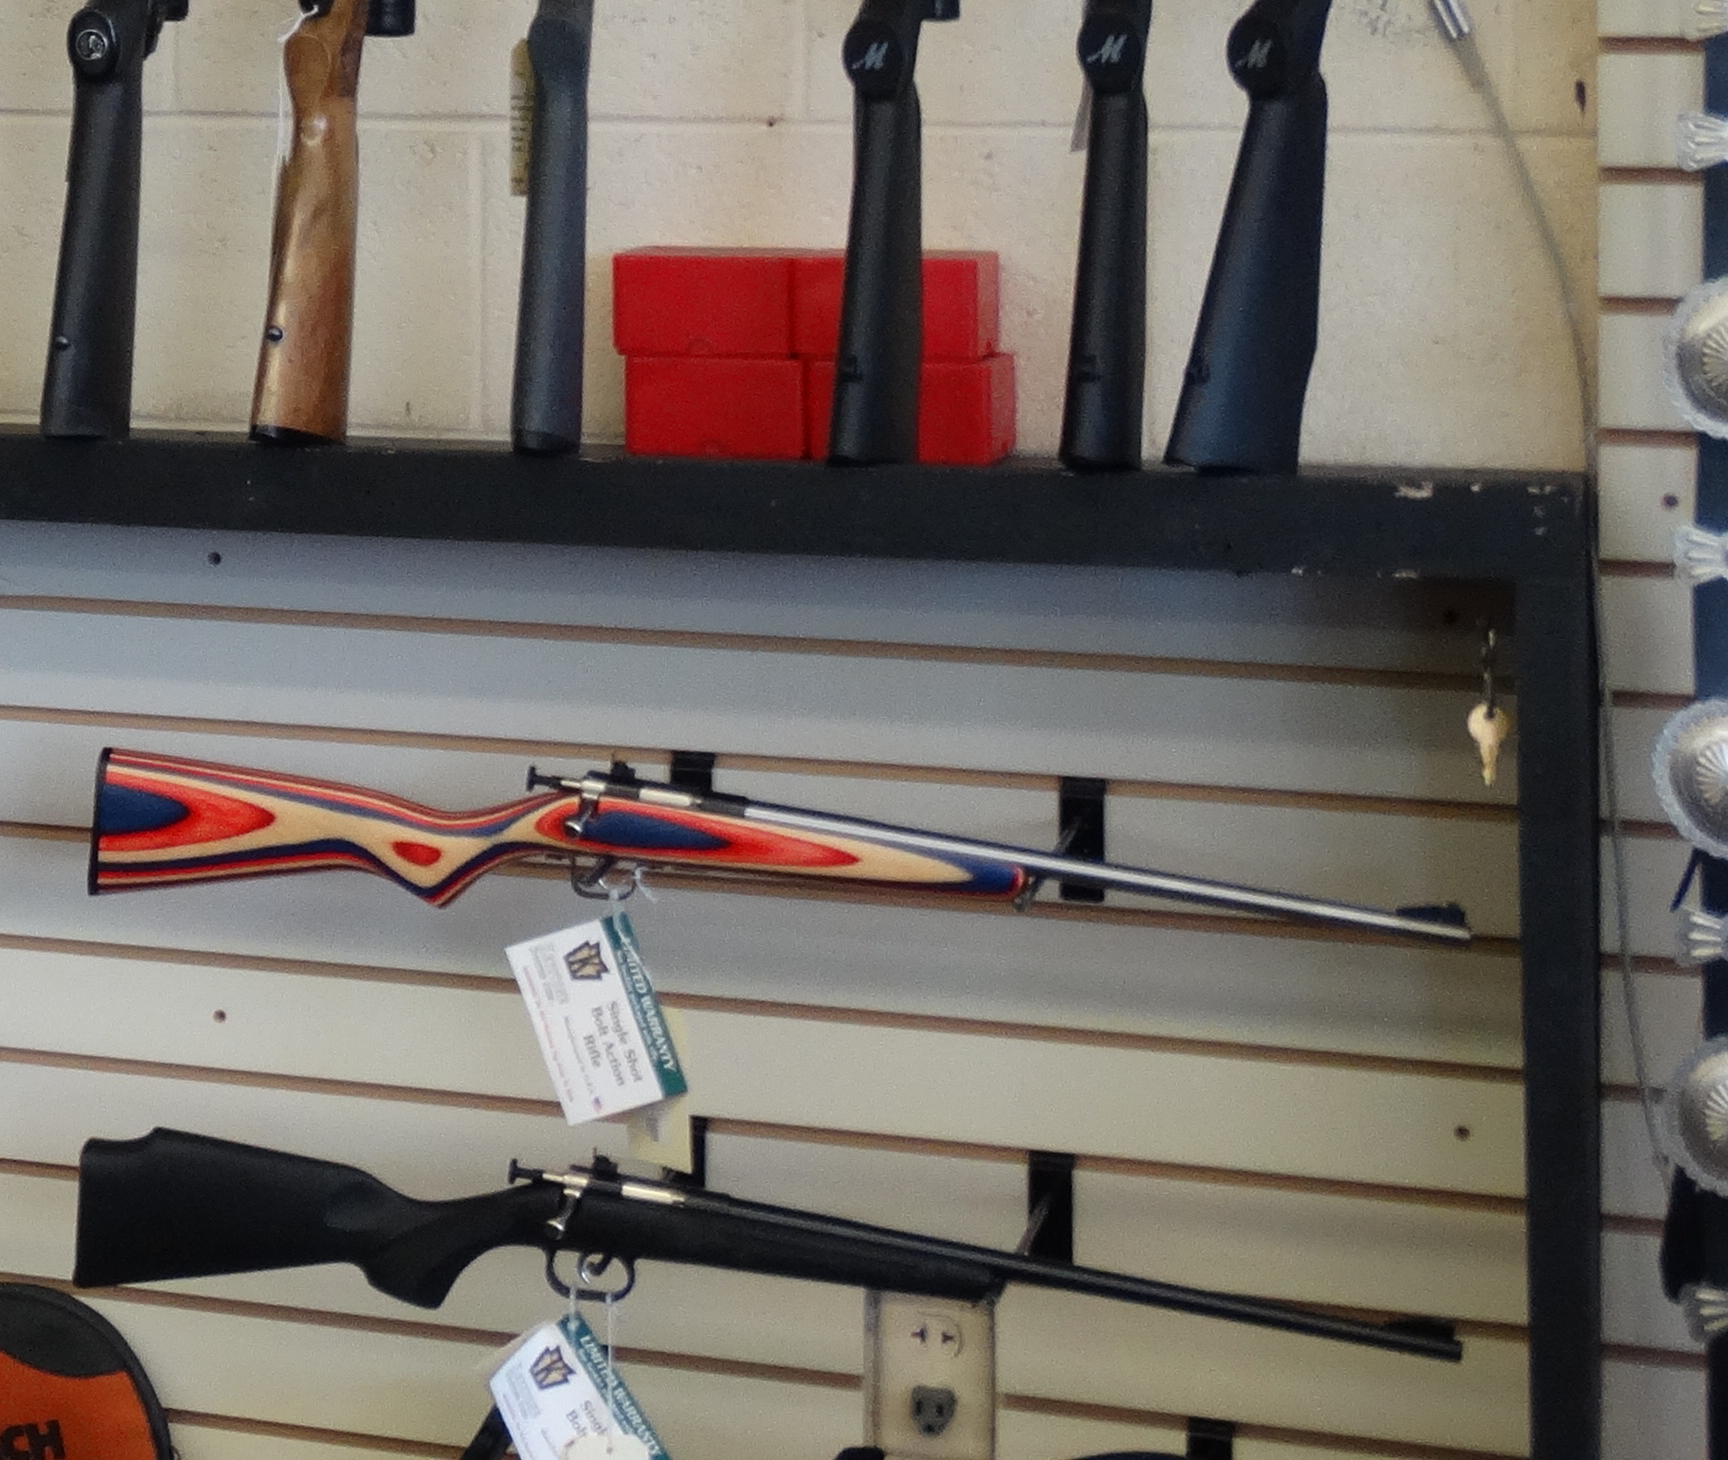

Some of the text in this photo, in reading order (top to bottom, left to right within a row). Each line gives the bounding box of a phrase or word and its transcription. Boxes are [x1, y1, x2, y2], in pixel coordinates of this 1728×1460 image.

[591, 1005, 625, 1087] Bolt Action
[607, 1000, 627, 1045] Single
[624, 1049, 643, 1083] Shot
[641, 994, 677, 1072] WARRANTY
